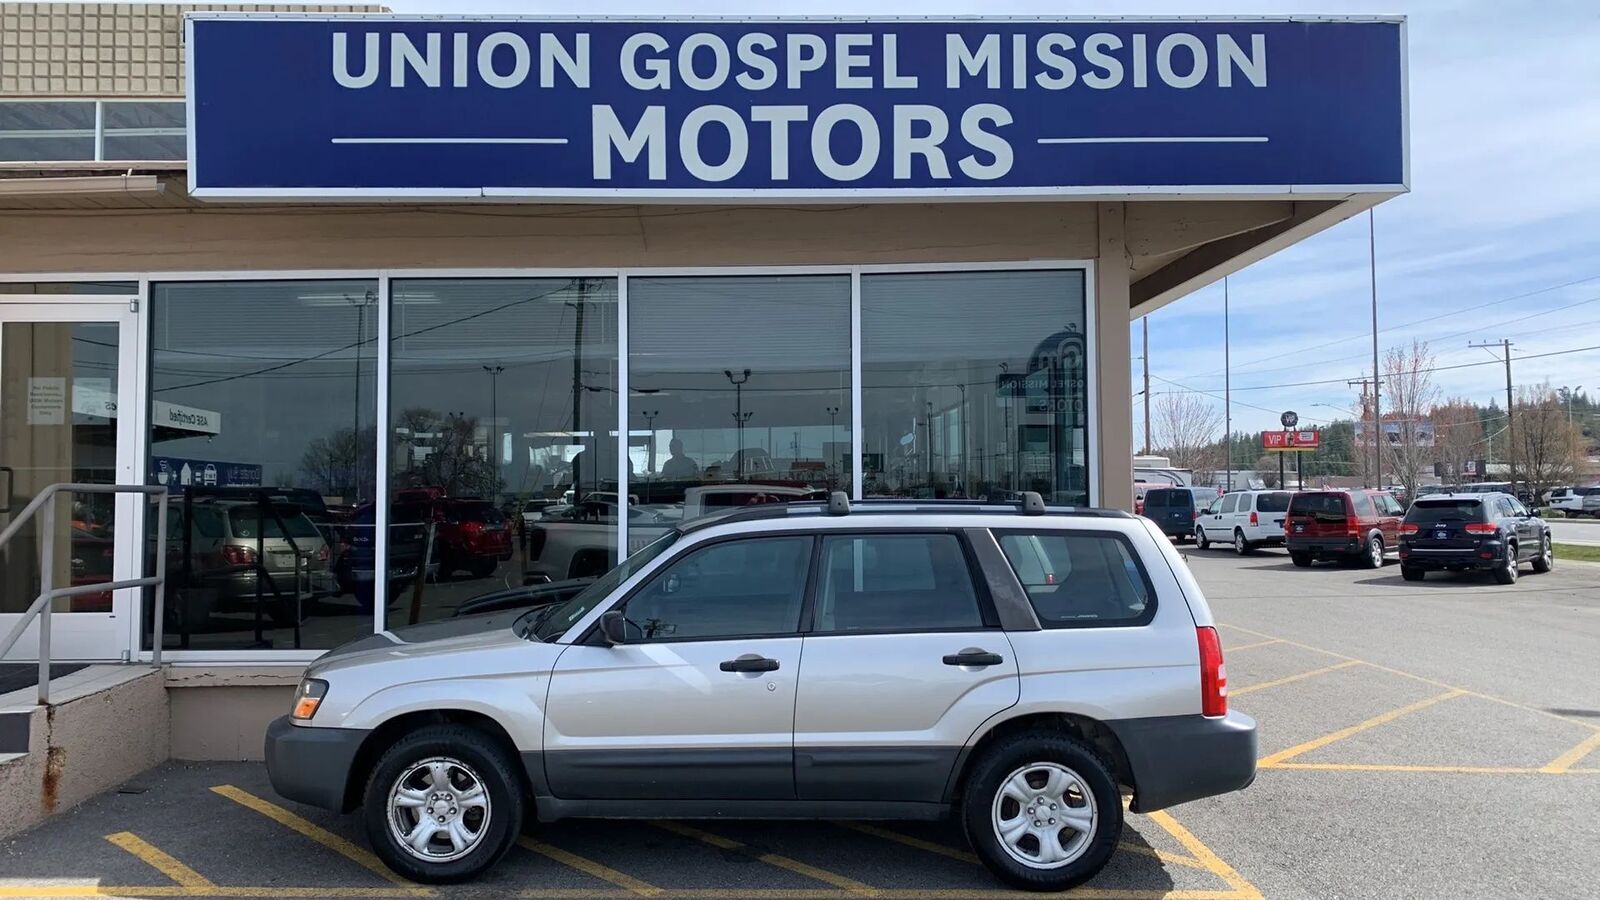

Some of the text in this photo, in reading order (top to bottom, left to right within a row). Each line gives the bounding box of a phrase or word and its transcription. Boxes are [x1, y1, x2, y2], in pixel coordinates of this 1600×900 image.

[332, 32, 1267, 91] UNION GOSPEL MISSION
[592, 103, 1014, 182] MOTORS
[1268, 434, 1282, 445] VIP
